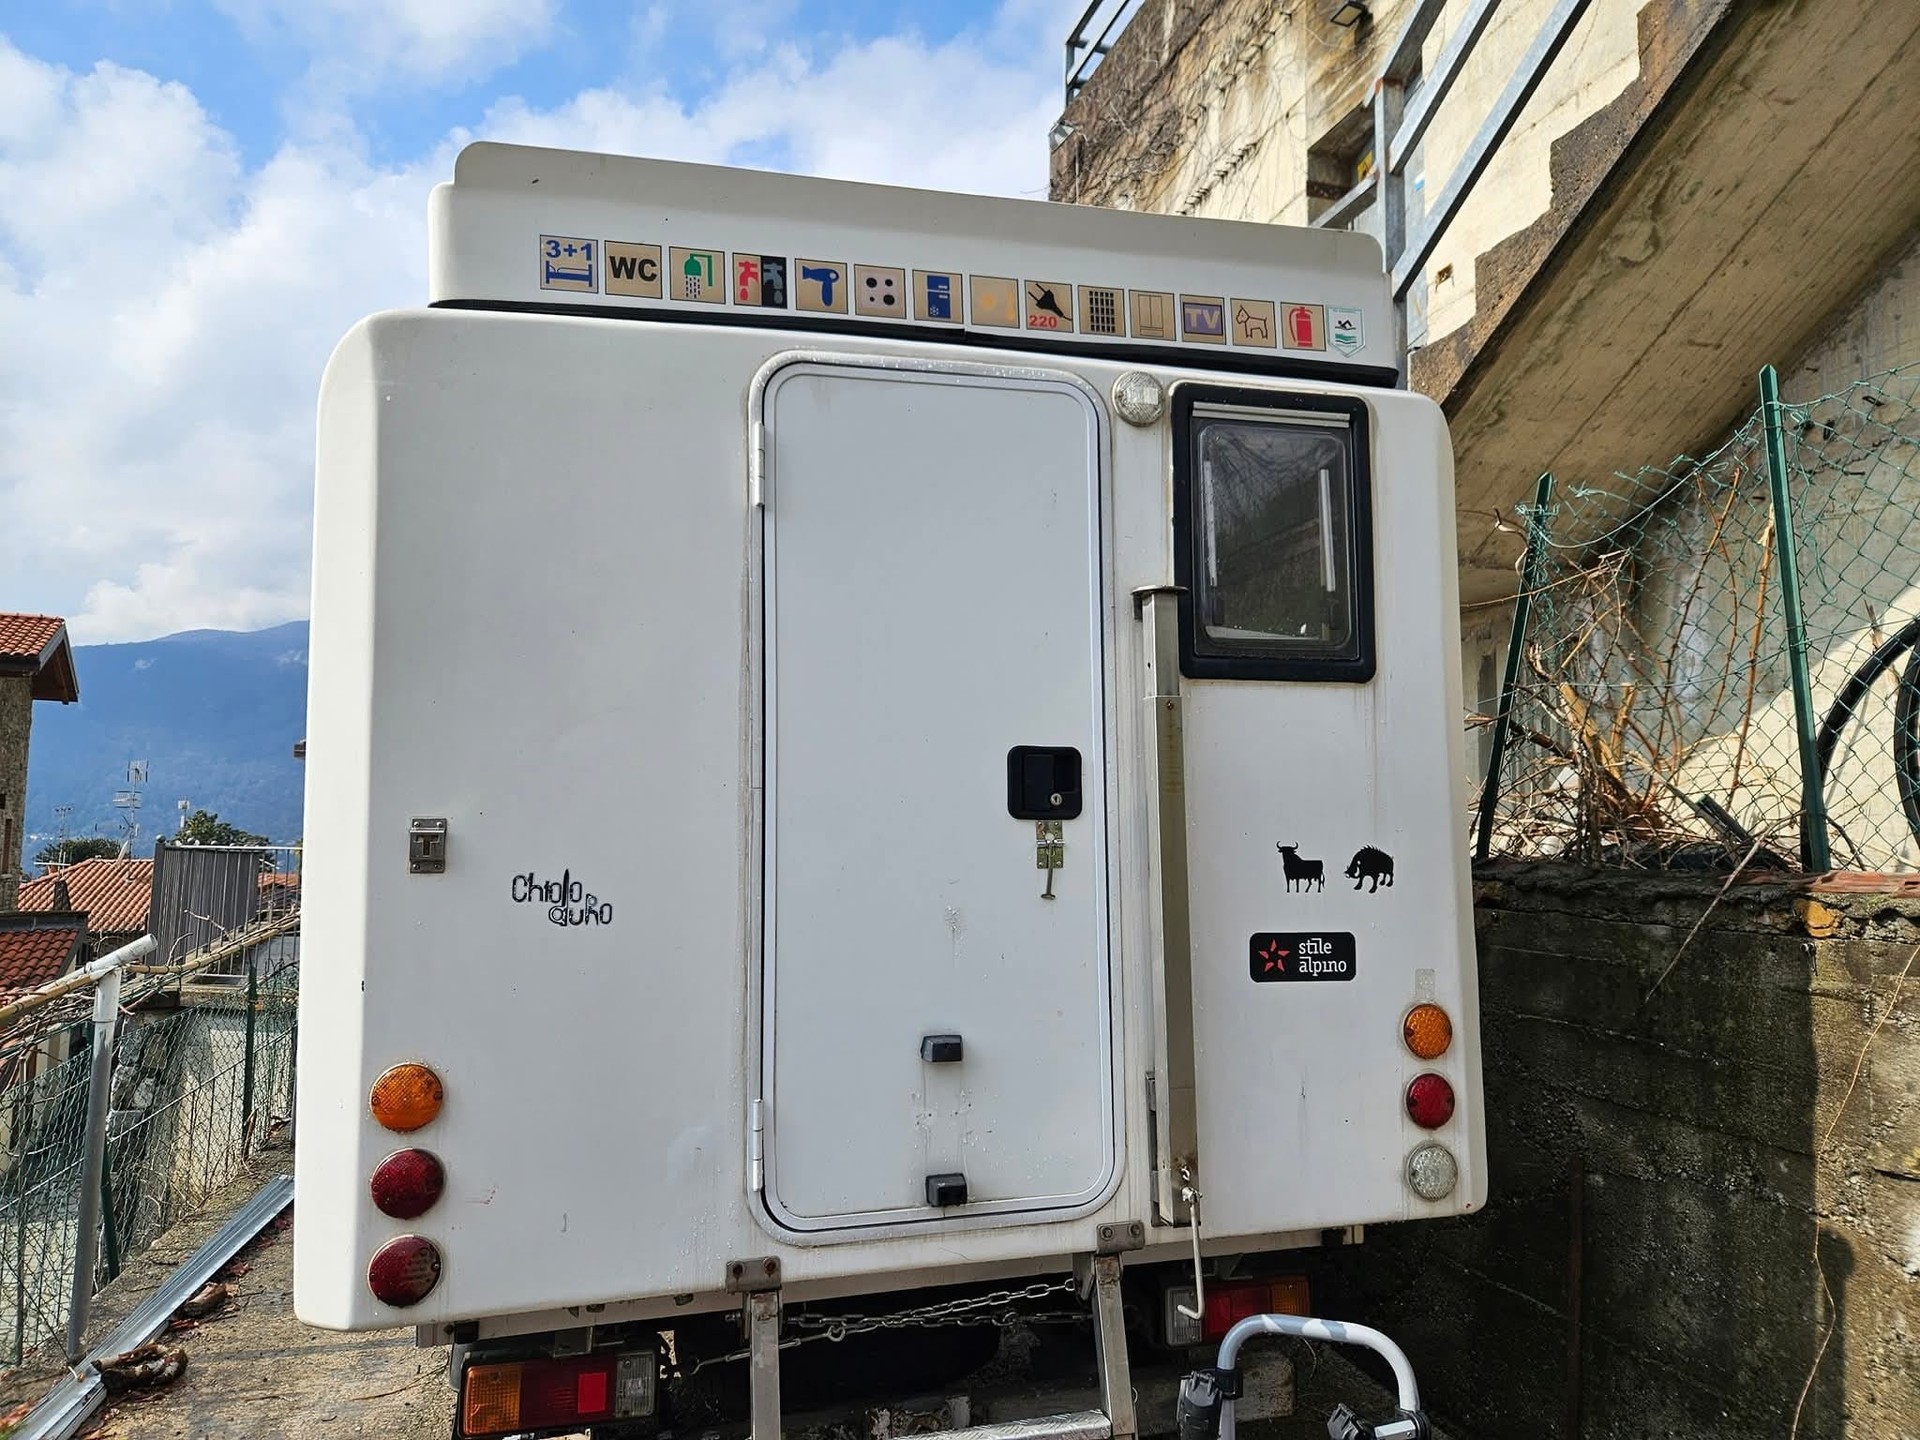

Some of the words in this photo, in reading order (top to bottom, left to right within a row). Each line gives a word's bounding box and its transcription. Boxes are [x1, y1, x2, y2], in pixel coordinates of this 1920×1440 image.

[545, 239, 592, 261] 3+1
[609, 255, 658, 282] WC
[1028, 315, 1058, 329] 220
[1185, 307, 1220, 330] TV
[1298, 937, 1333, 955] stile
[1298, 956, 1348, 977] alpino
